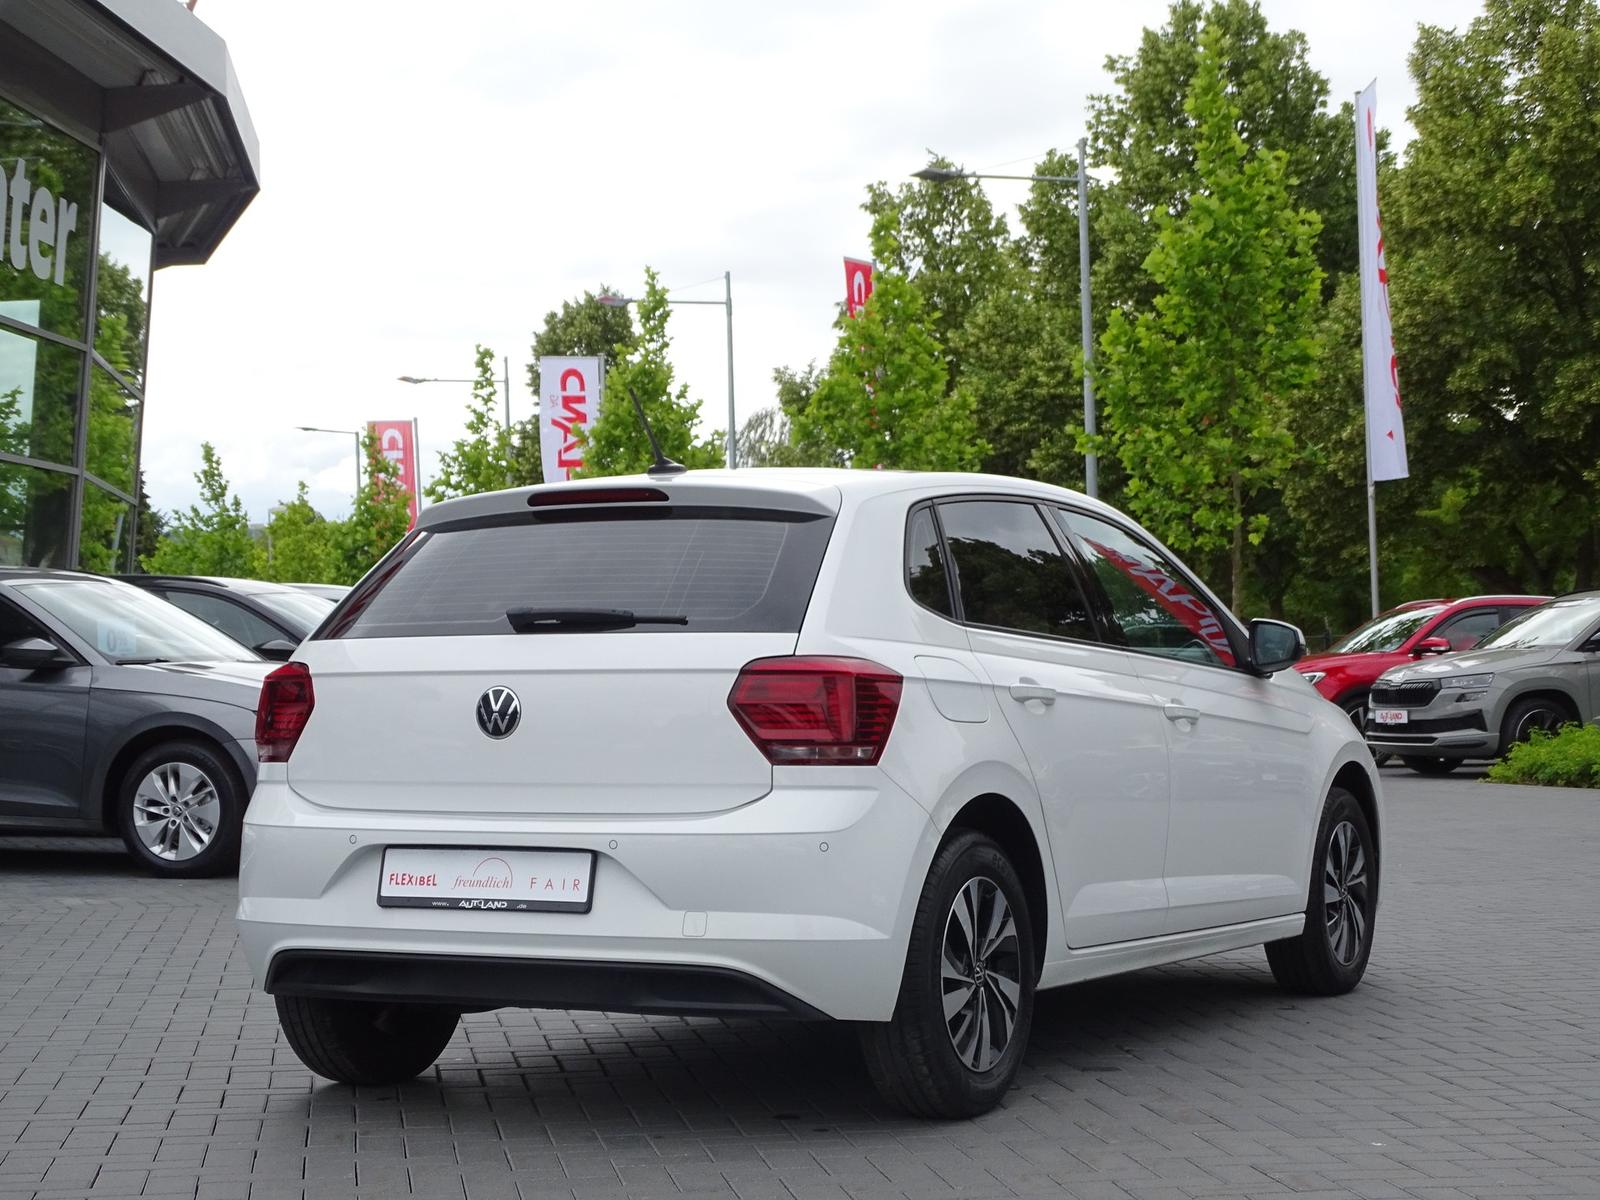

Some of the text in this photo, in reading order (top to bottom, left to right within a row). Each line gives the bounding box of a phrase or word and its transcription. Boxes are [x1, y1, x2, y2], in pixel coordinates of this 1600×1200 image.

[389, 873, 581, 891] FLEXIBEL freundlich FAIR
